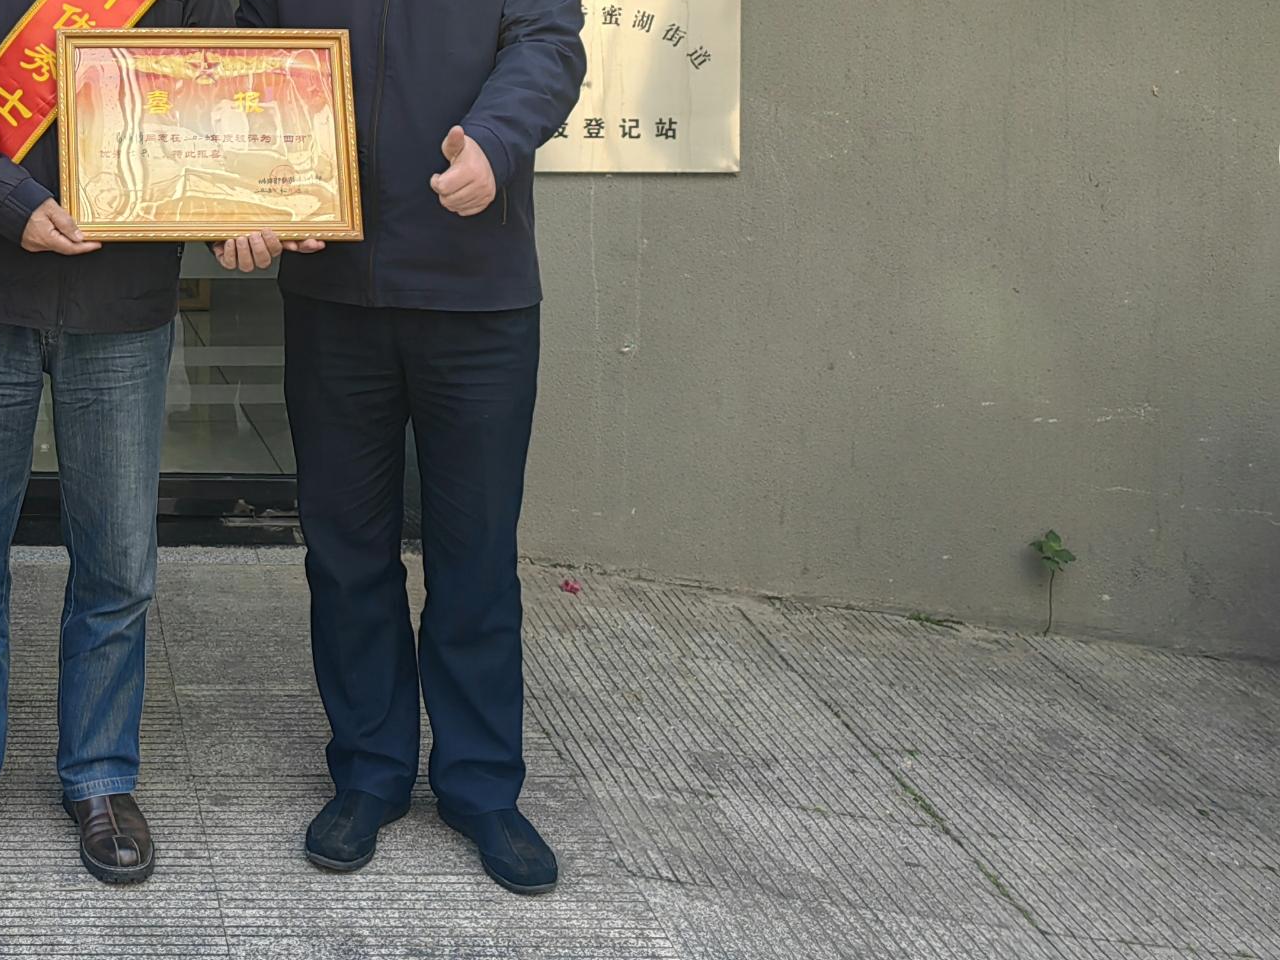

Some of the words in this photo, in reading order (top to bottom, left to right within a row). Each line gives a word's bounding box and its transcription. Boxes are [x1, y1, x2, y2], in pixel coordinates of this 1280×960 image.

[581, 5, 711, 70] 蜜湖街道
[143, 90, 264, 115] 喜报
